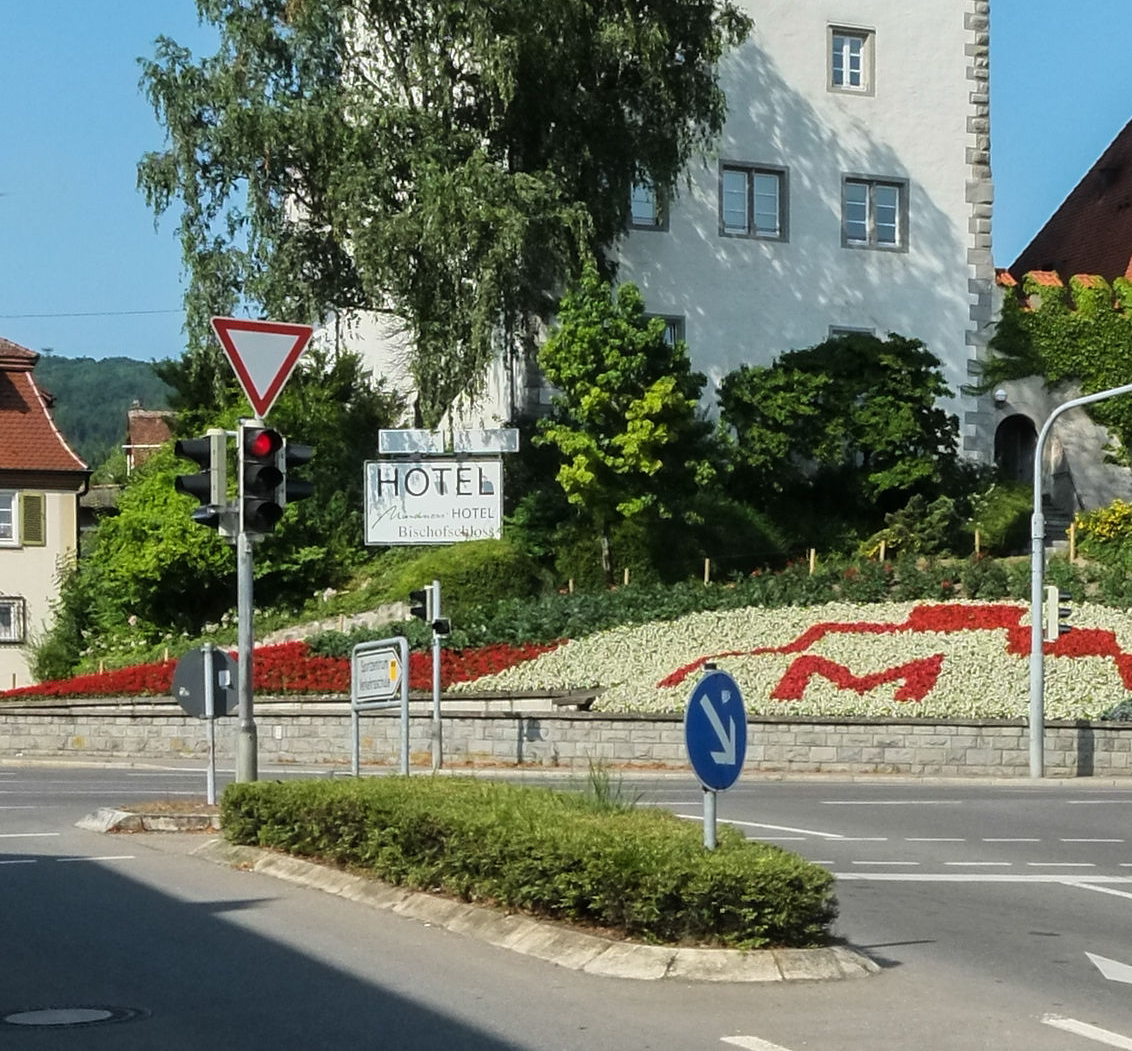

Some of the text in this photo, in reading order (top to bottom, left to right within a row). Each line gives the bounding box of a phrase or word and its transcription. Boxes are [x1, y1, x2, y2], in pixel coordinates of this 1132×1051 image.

[377, 467, 495, 497] HOTEL
[452, 508, 495, 520] HOTEL
[398, 526, 495, 538] Bischofschloss
